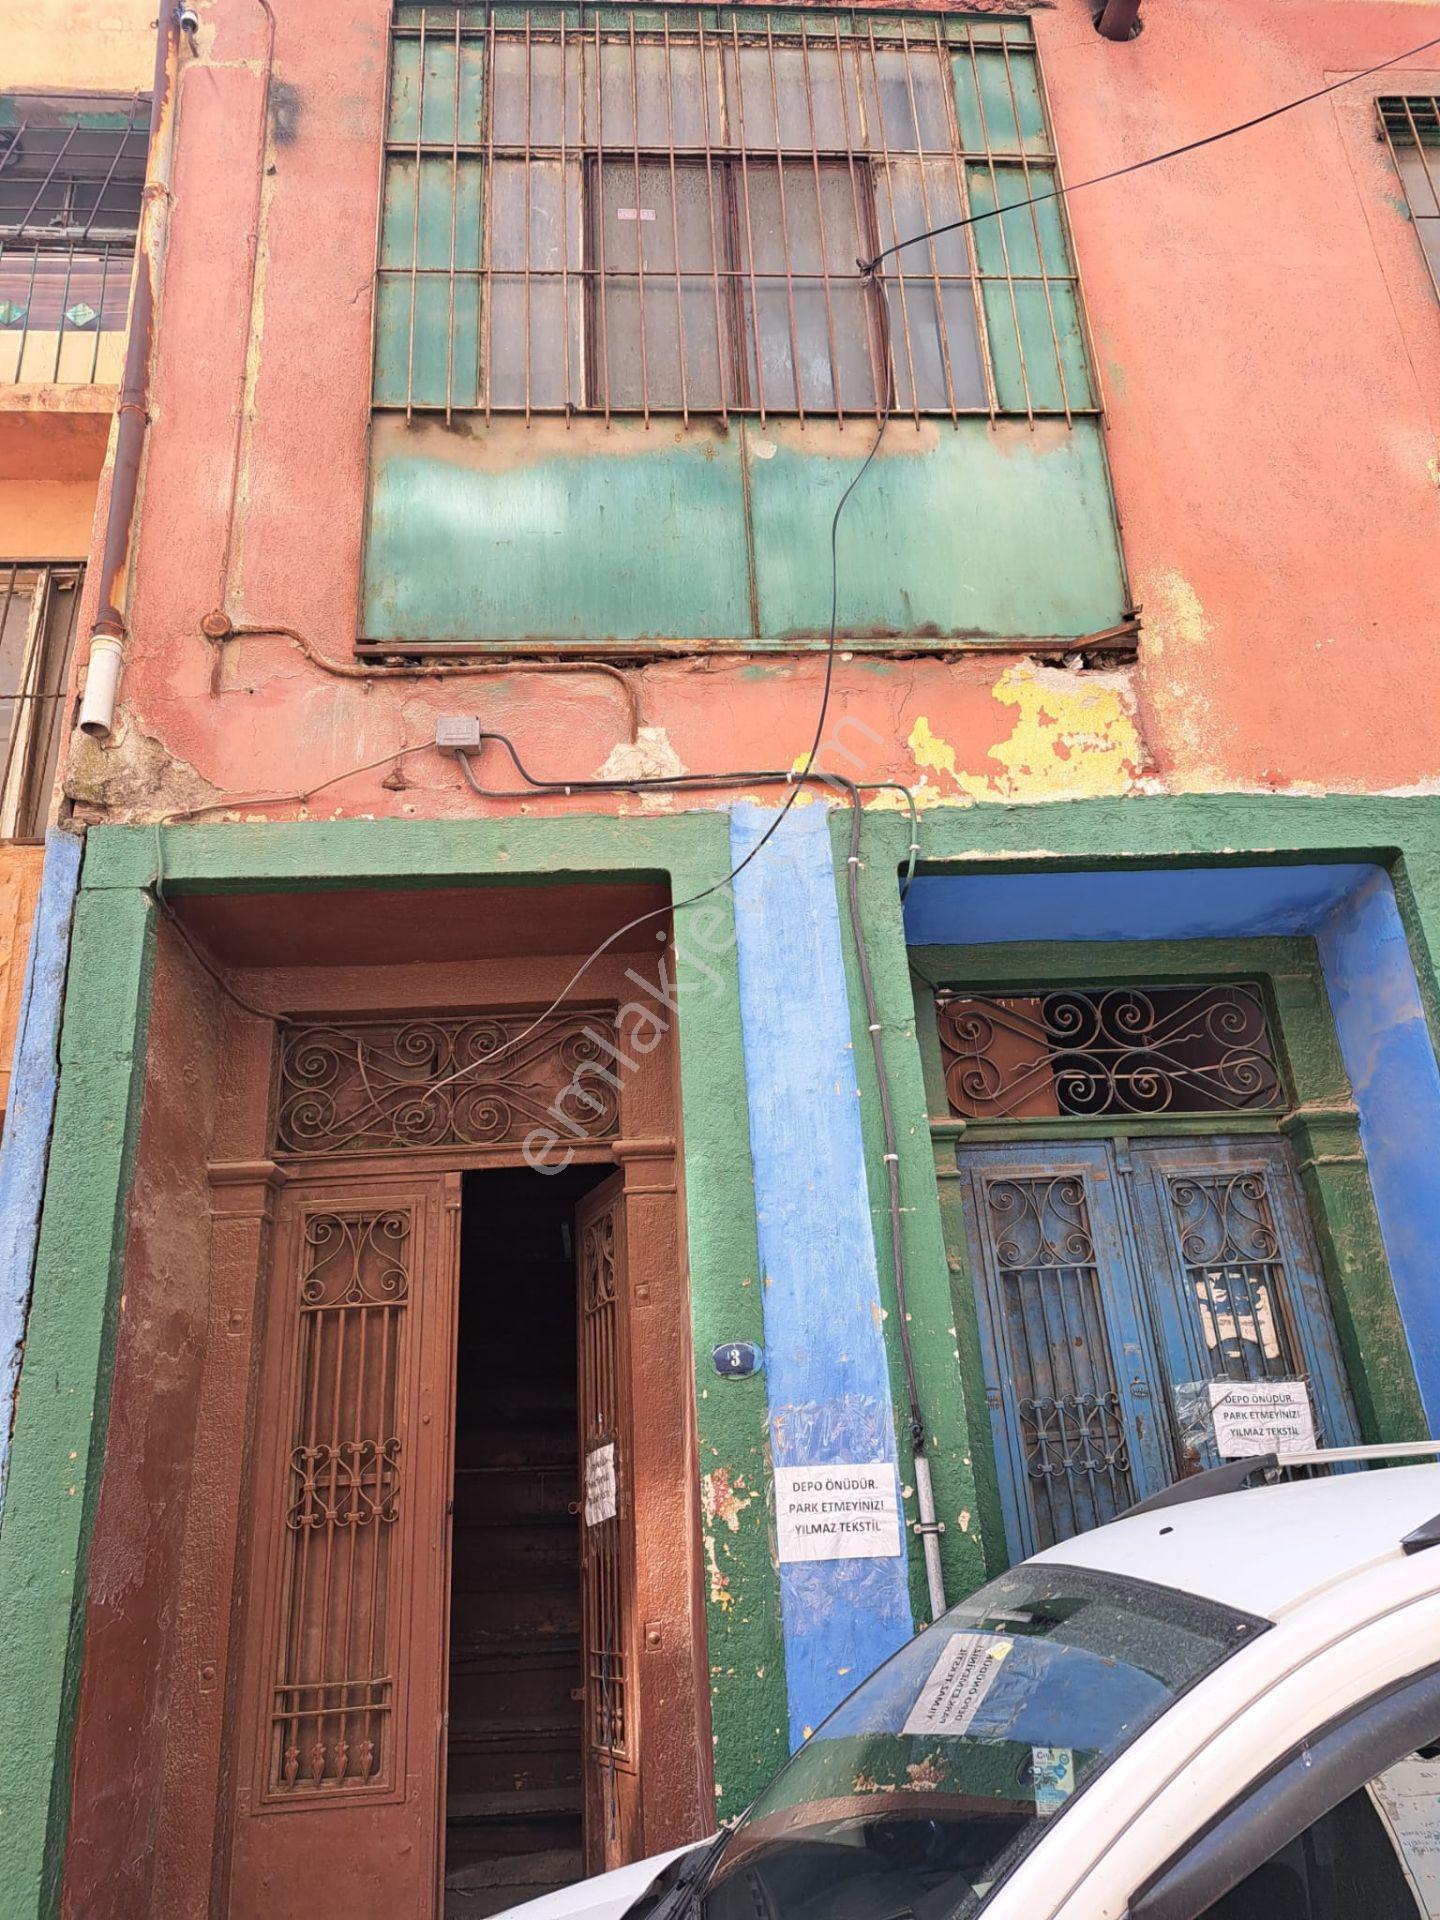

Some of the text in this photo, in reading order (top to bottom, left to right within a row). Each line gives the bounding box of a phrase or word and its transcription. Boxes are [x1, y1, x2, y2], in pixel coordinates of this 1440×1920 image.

[730, 1349, 740, 1367] 3
[1225, 1395, 1250, 1404] DEPO
[1223, 1411, 1248, 1420] PARK
[1230, 1425, 1300, 1437] YILMAZ TEKSTİL
[792, 1477, 879, 1492] DEPO ÖNÜDÜR.
[789, 1498, 884, 1514] PARK ETMEYİNİZ!
[795, 1520, 882, 1535] YILMAZ TEKSTİL
